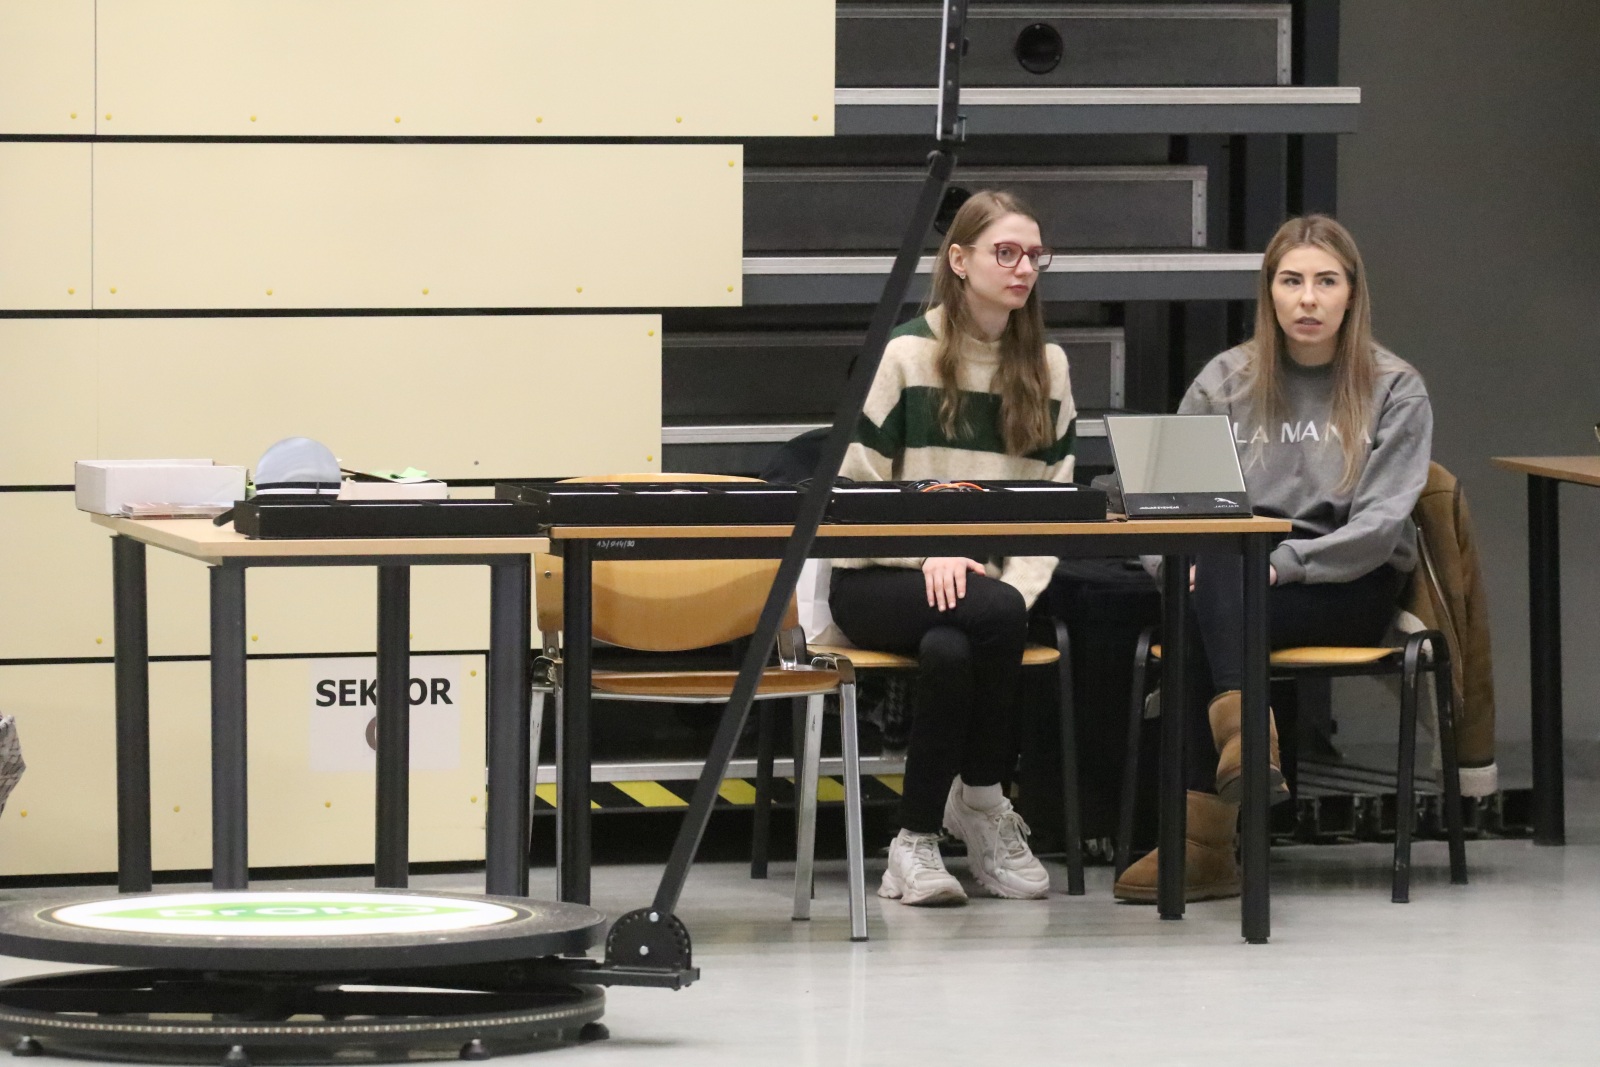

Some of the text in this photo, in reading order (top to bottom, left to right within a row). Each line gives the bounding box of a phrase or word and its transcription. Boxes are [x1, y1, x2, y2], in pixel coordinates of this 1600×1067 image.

[1233, 420, 1372, 443] LA MANA
[315, 678, 453, 707] SEKOR
